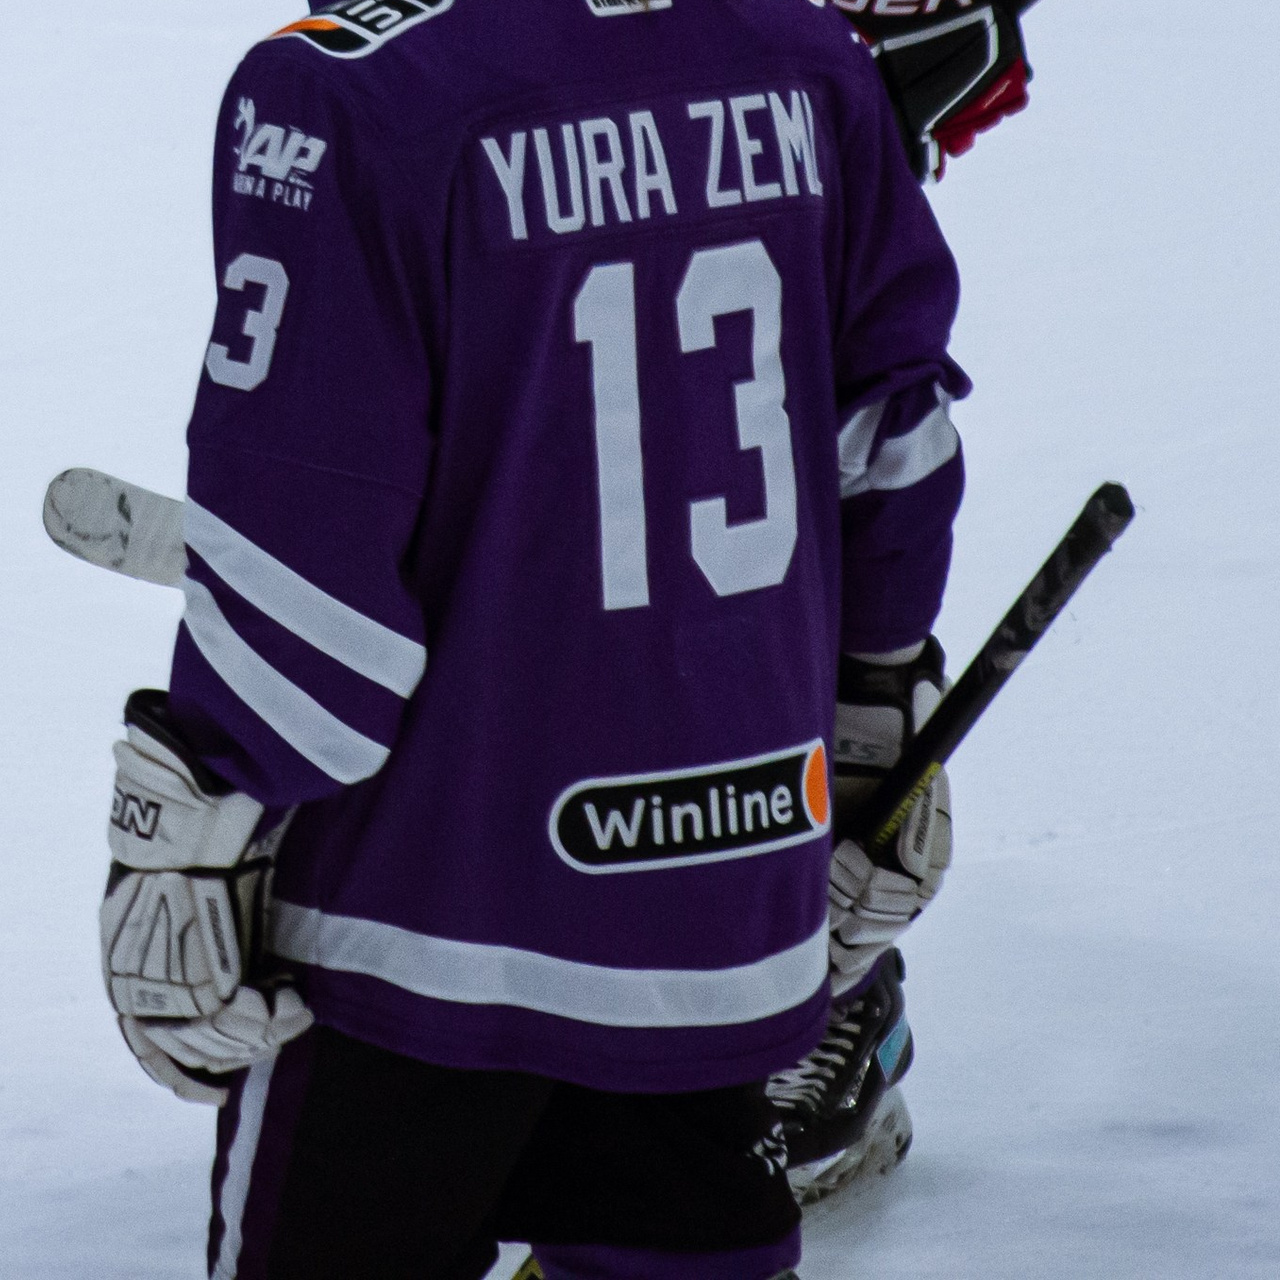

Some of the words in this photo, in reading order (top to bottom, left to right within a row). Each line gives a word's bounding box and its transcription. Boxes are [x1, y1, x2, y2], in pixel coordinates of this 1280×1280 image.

[271, 182, 313, 212] PLAY
[480, 110, 680, 241] YURA
[574, 239, 798, 611] 13
[582, 783, 794, 851] Winline
